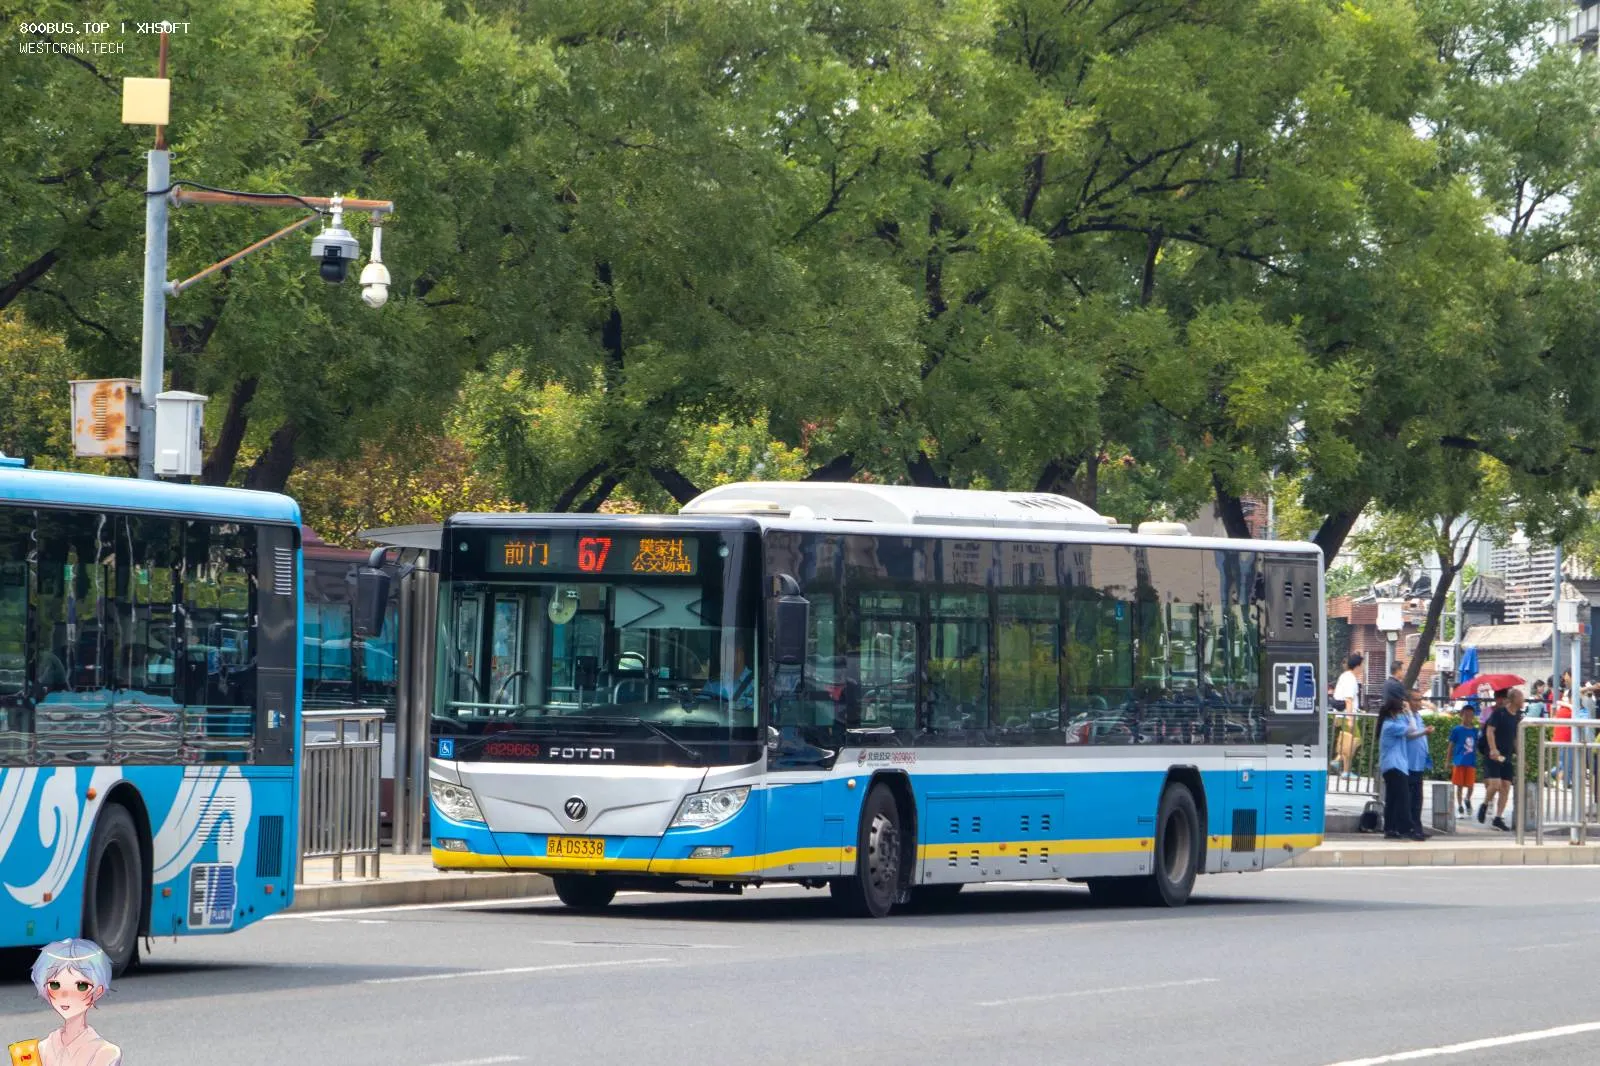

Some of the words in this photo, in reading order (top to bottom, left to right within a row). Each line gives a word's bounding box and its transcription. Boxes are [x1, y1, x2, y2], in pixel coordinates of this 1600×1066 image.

[504, 540, 549, 566] 前门
[577, 536, 612, 572] 67
[549, 747, 615, 760] FOTON
